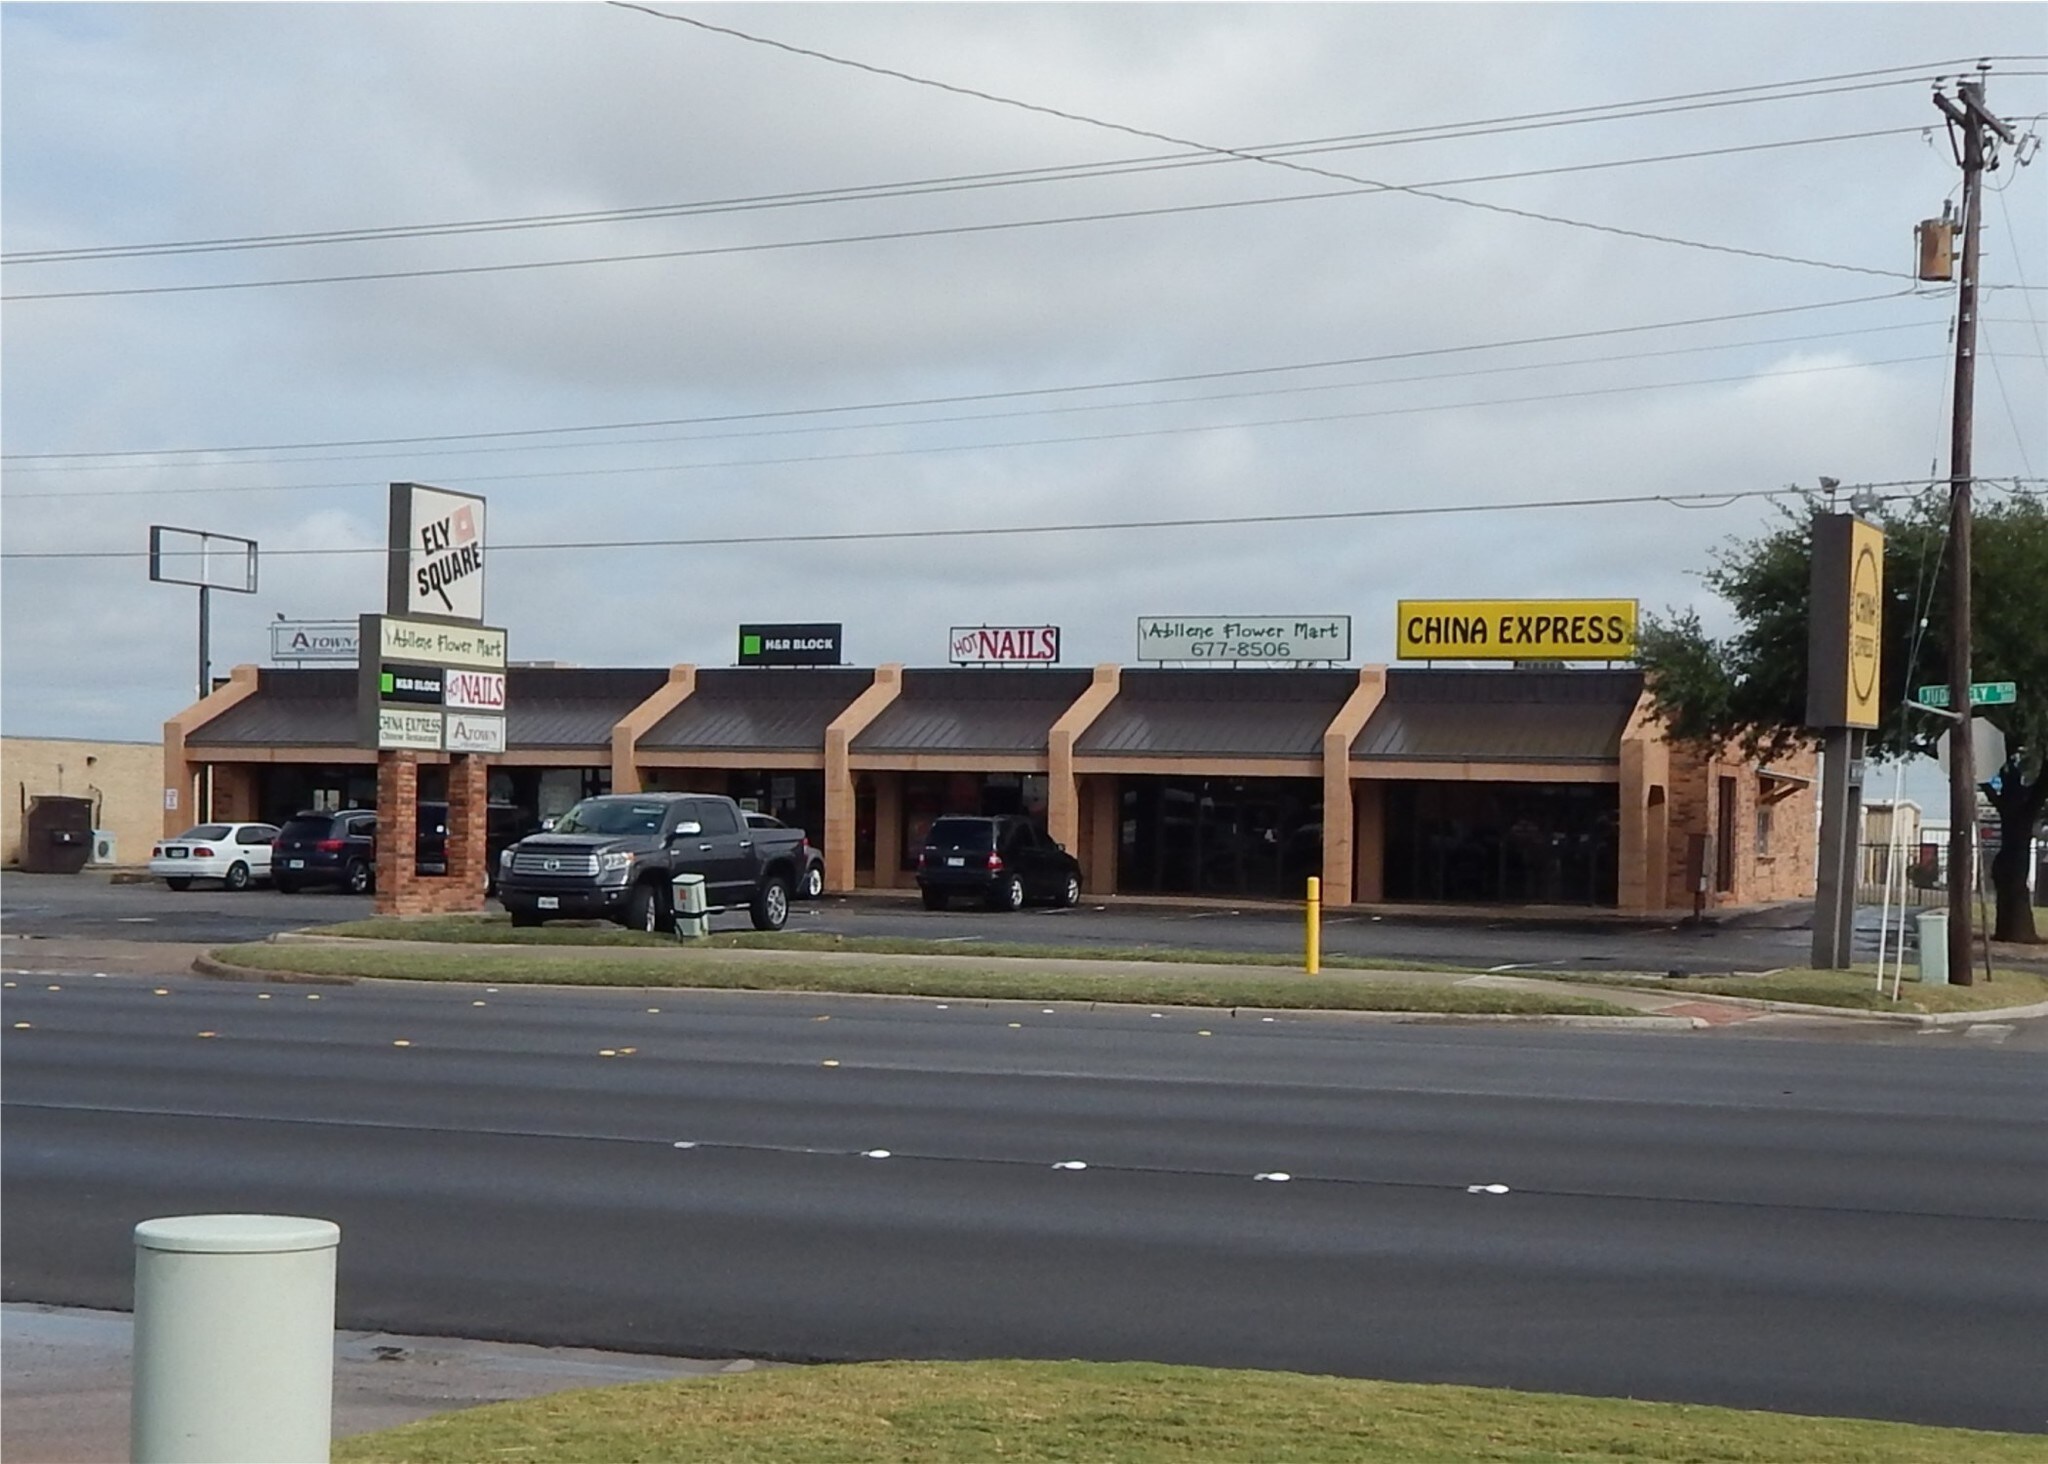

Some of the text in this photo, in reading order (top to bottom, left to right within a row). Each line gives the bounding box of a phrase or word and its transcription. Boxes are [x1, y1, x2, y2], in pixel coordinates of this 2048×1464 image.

[421, 517, 450, 556] ELY
[417, 541, 482, 612] SQUARE
[1223, 623, 1285, 639] Flower
[1294, 623, 1339, 640] Mart
[1407, 616, 1624, 644] CHINA EXPRESS
[438, 634, 473, 653] Flower
[477, 638, 502, 657] Mart
[765, 638, 833, 650] H&R BLOCK
[953, 629, 1055, 659] HOT NAILS
[1191, 642, 1290, 657] 677-8506
[414, 679, 441, 692] BLOCK
[460, 674, 504, 706] NAILS
